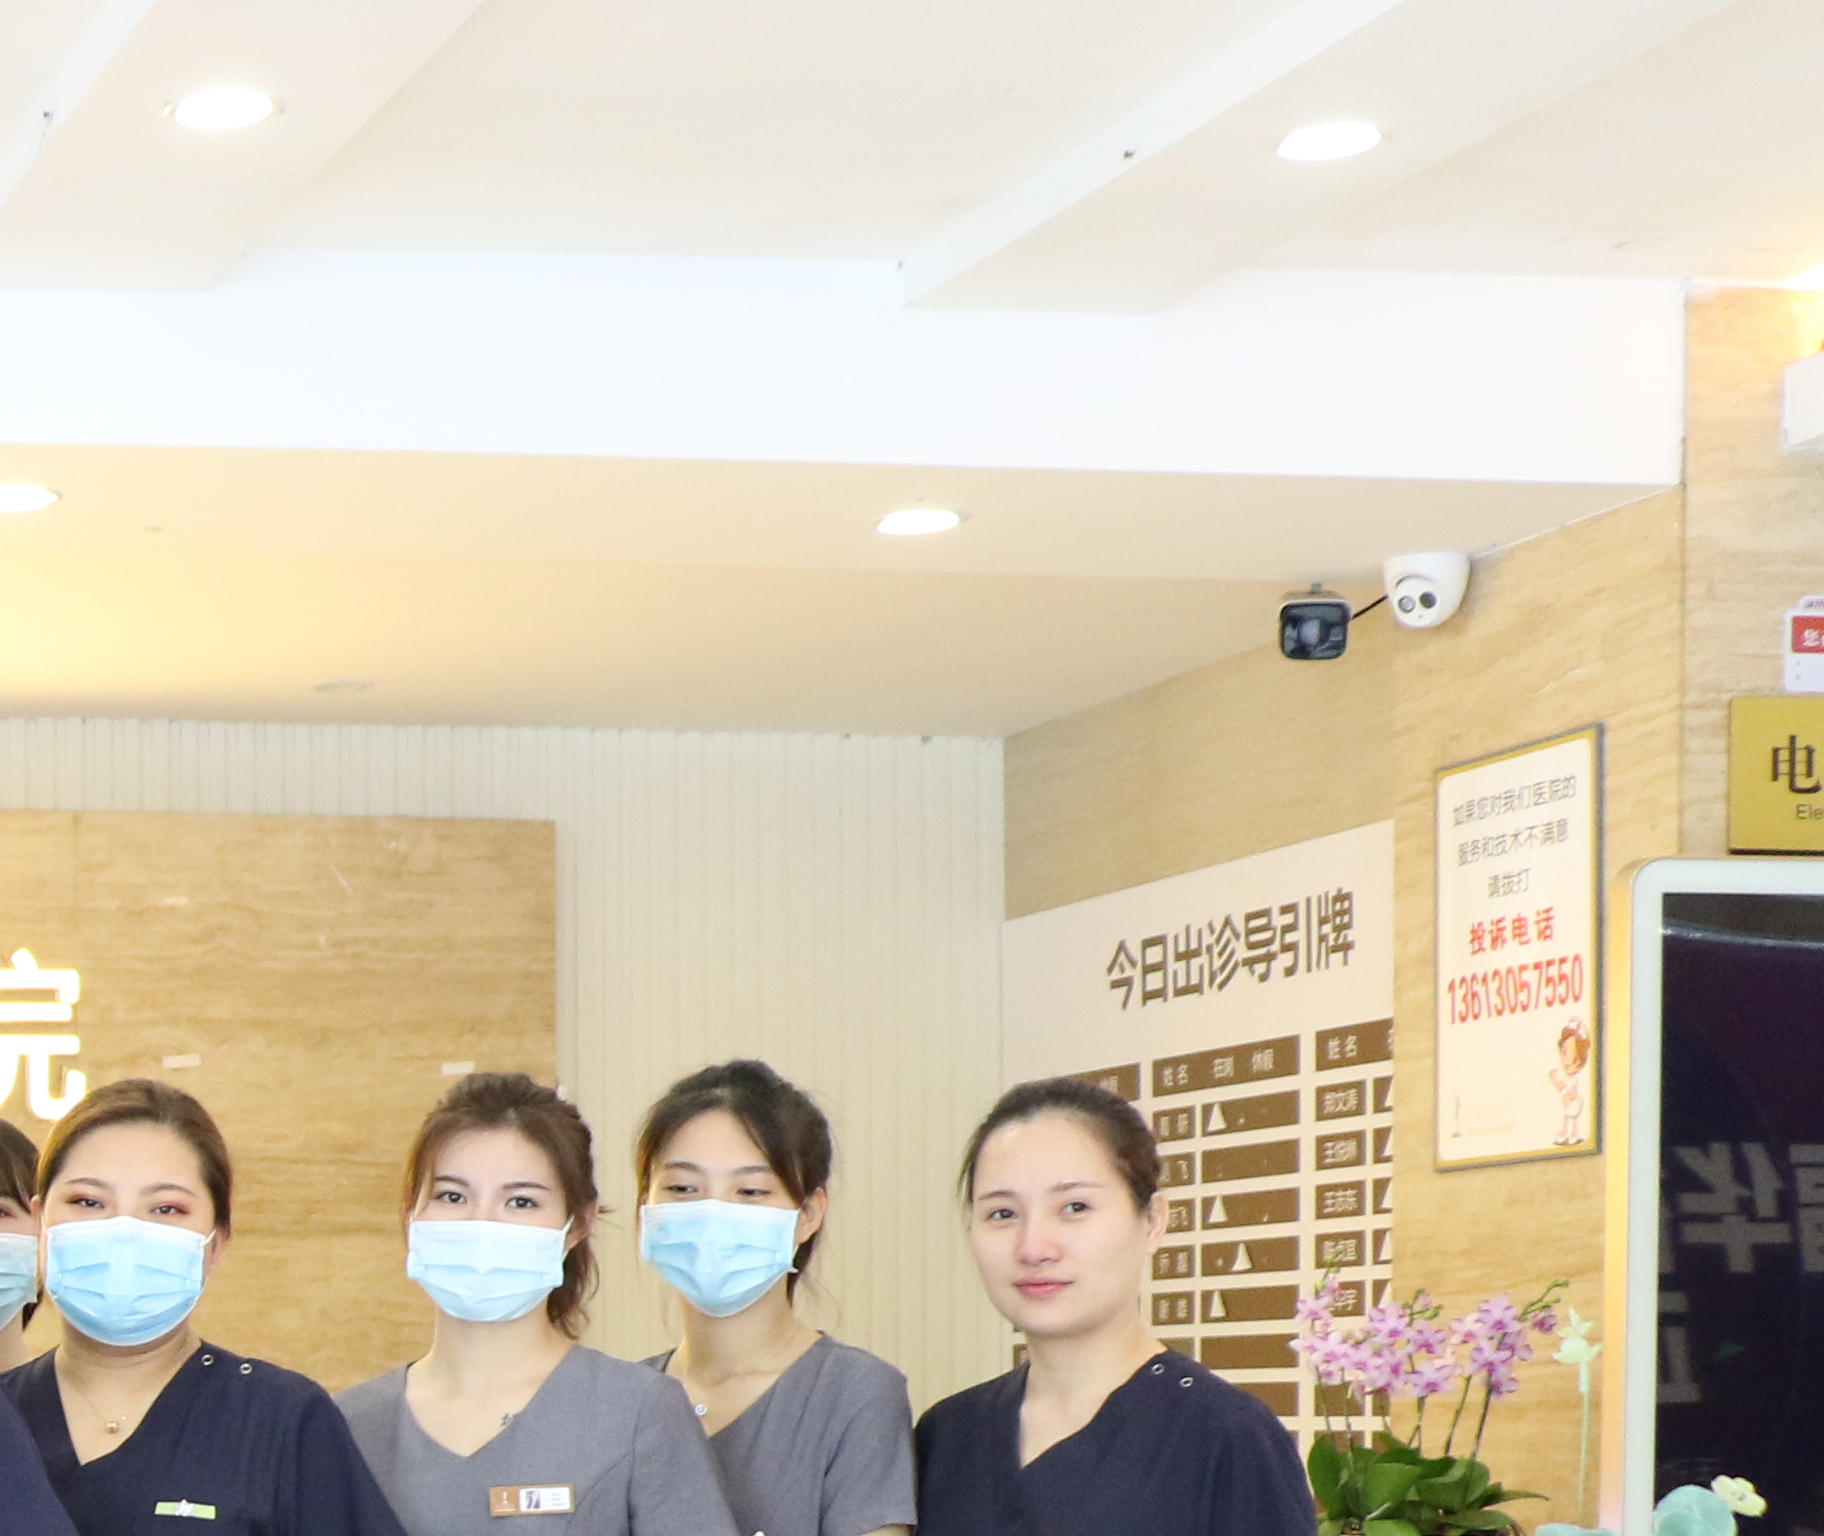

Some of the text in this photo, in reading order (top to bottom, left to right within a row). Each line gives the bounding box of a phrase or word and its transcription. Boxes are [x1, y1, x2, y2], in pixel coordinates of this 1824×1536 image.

[1772, 735, 1822, 794] 电
[1107, 887, 1356, 1010] 今日出诊导引牌
[1469, 906, 1555, 956] 投诉电话
[1448, 953, 1584, 1025] 13613057550
